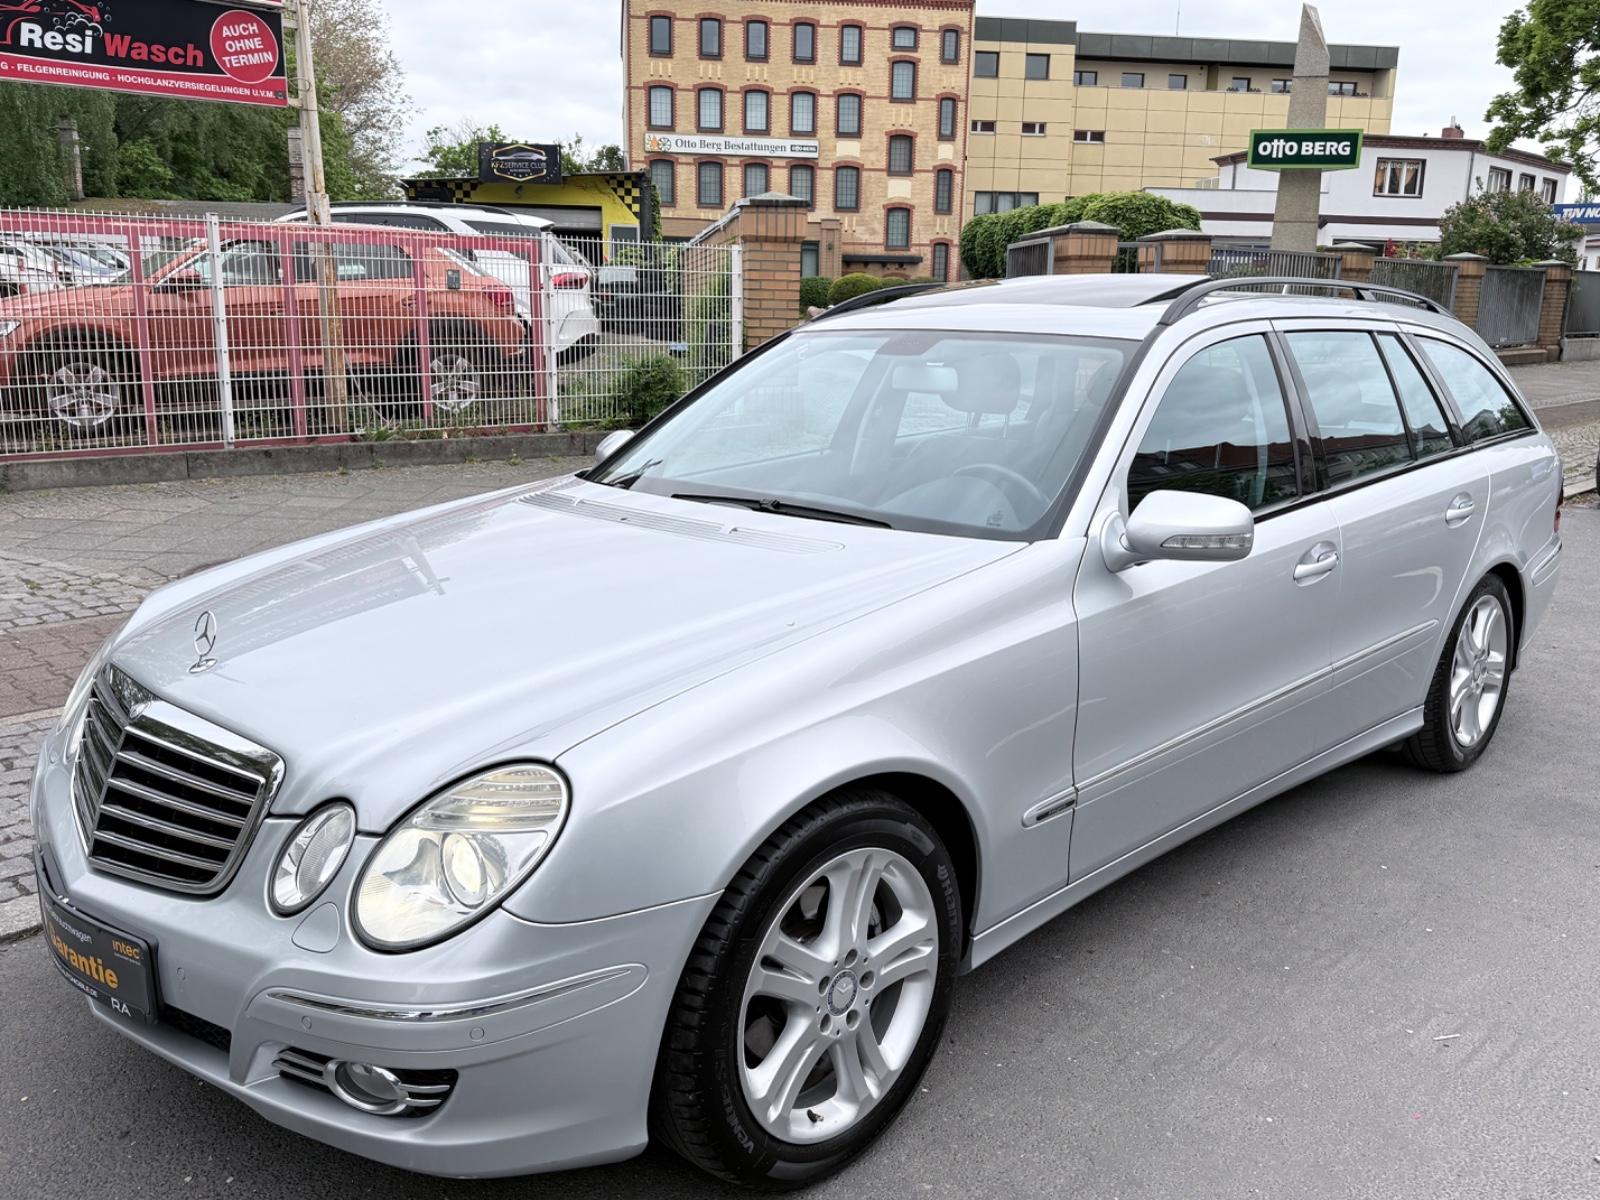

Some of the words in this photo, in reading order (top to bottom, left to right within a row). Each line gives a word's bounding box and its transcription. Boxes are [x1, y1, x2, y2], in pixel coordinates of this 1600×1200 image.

[222, 22, 259, 37] AUCH
[20, 22, 93, 54] Resi
[103, 32, 204, 67] Wasch
[225, 37, 264, 52] OHNE
[222, 51, 274, 68] TERMIN
[17, 63, 110, 81] FELGENREINIGUNG
[117, 74, 251, 96] HOCHGLANZVERSIEGELUNGEN
[675, 138, 697, 149] Otto
[699, 139, 722, 151] Berg
[724, 140, 787, 153] Bestattungen
[1300, 141, 1351, 156] BERG
[110, 997, 132, 1017] RA
